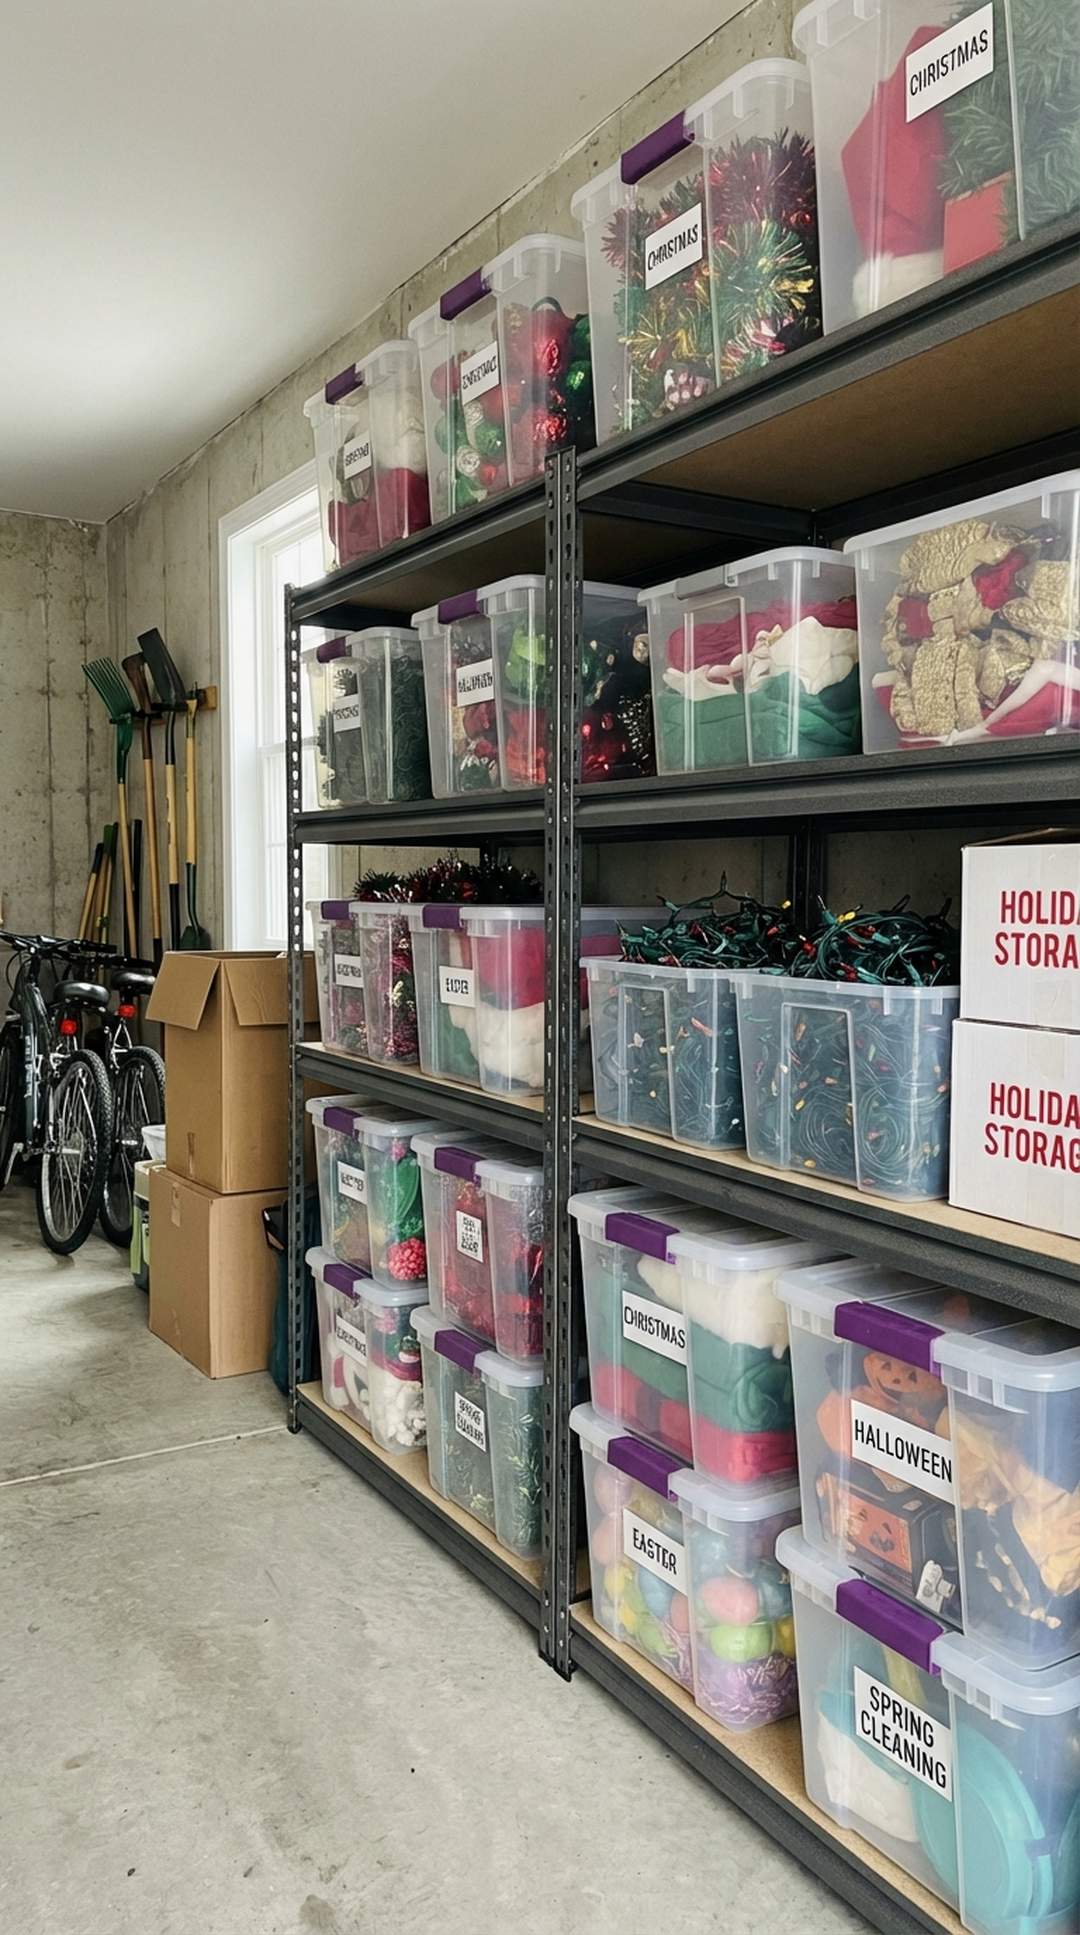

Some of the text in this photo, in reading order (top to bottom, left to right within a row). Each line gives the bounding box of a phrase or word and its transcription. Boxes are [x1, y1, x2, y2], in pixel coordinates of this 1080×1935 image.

[1001, 890, 1080, 925] HOLID
[855, 1419, 952, 1483] HALLOWEEN
[632, 1527, 678, 1575] EASTER
[870, 1685, 934, 1748] SPRING
[861, 1710, 946, 1788] CLEANING
